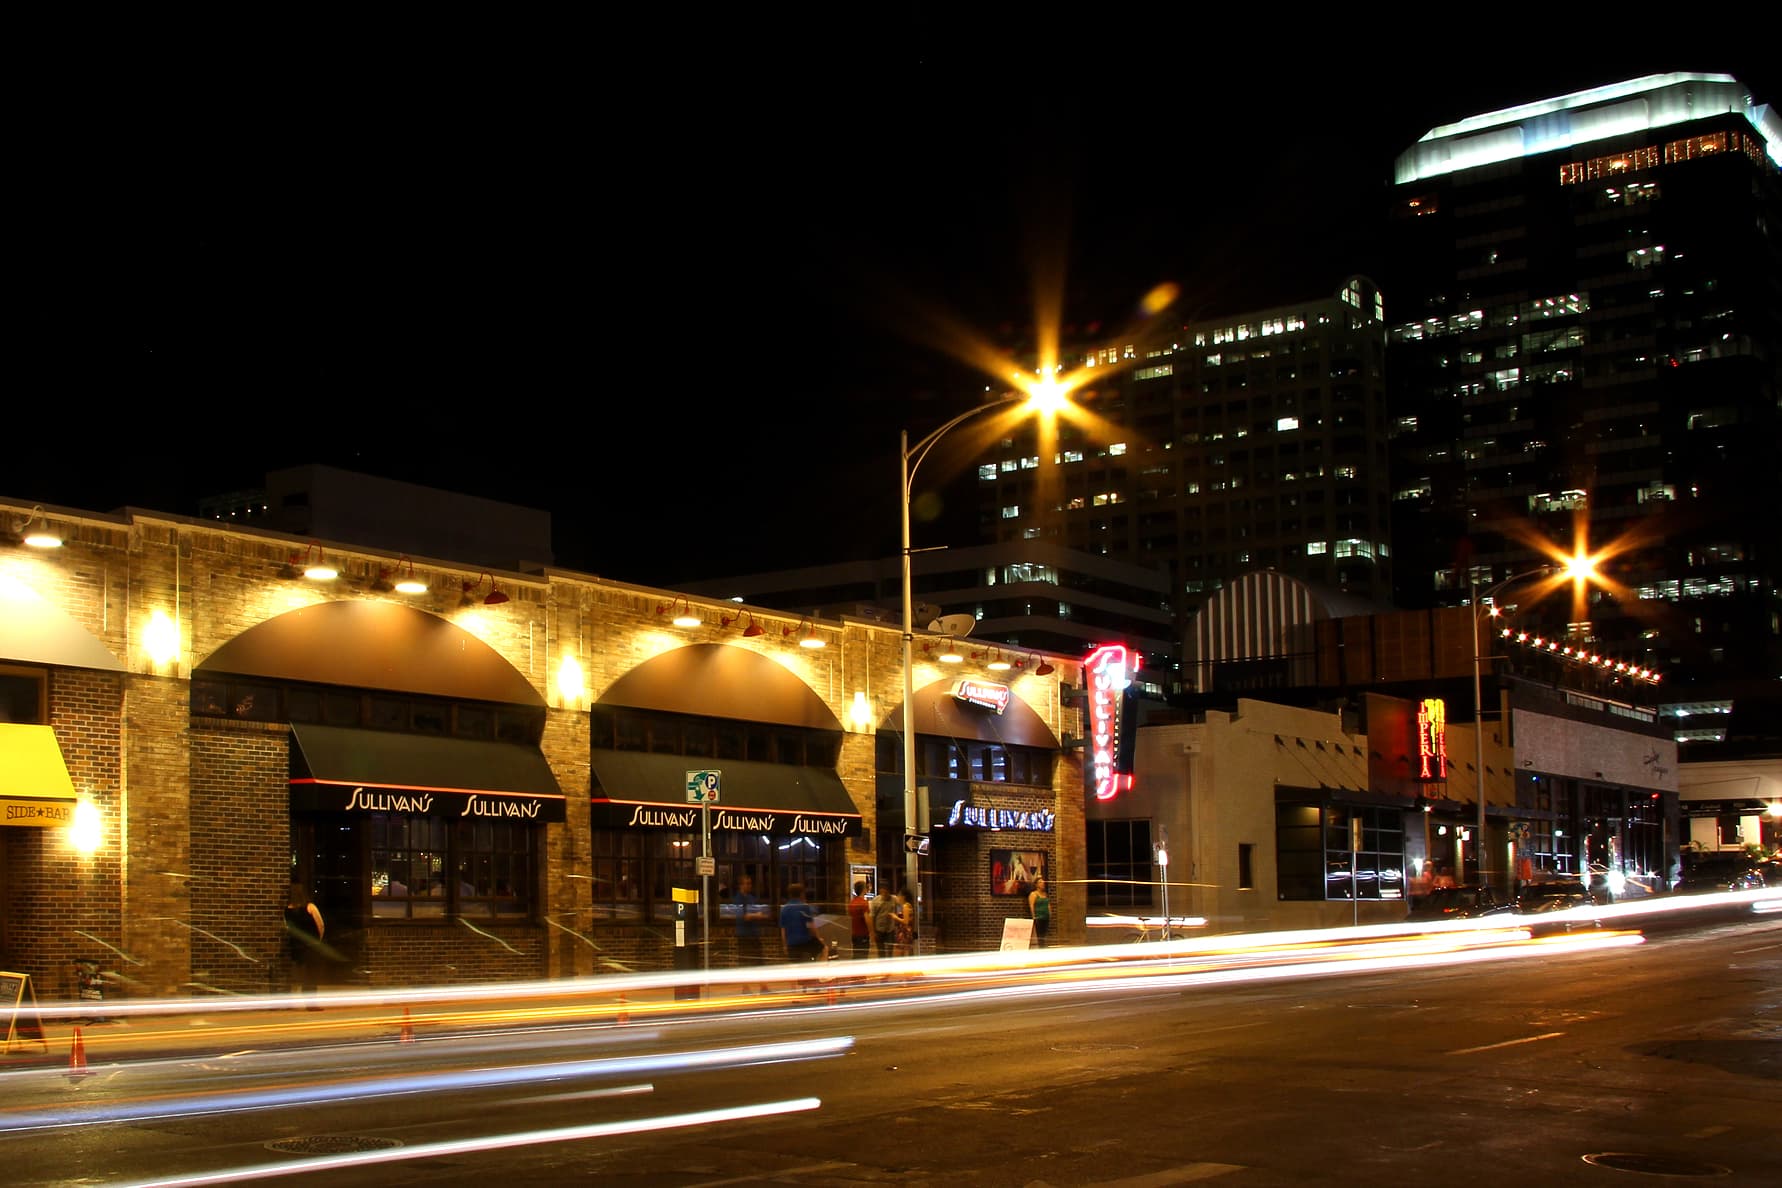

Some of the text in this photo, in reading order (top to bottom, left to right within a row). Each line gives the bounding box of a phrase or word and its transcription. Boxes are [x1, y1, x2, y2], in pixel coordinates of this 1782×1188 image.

[1418, 701, 1434, 778] IMPERIA
[345, 787, 434, 813] SULLIVAN'S
[461, 794, 542, 818] SULLIVAN'S
[7, 805, 36, 819] SIDE
[629, 805, 697, 827] SULLIVAN'S
[713, 810, 775, 831] SULLIVAN'S
[949, 799, 1055, 832] SULLIVAN'S
[790, 814, 848, 835] SULLIVAN'S
